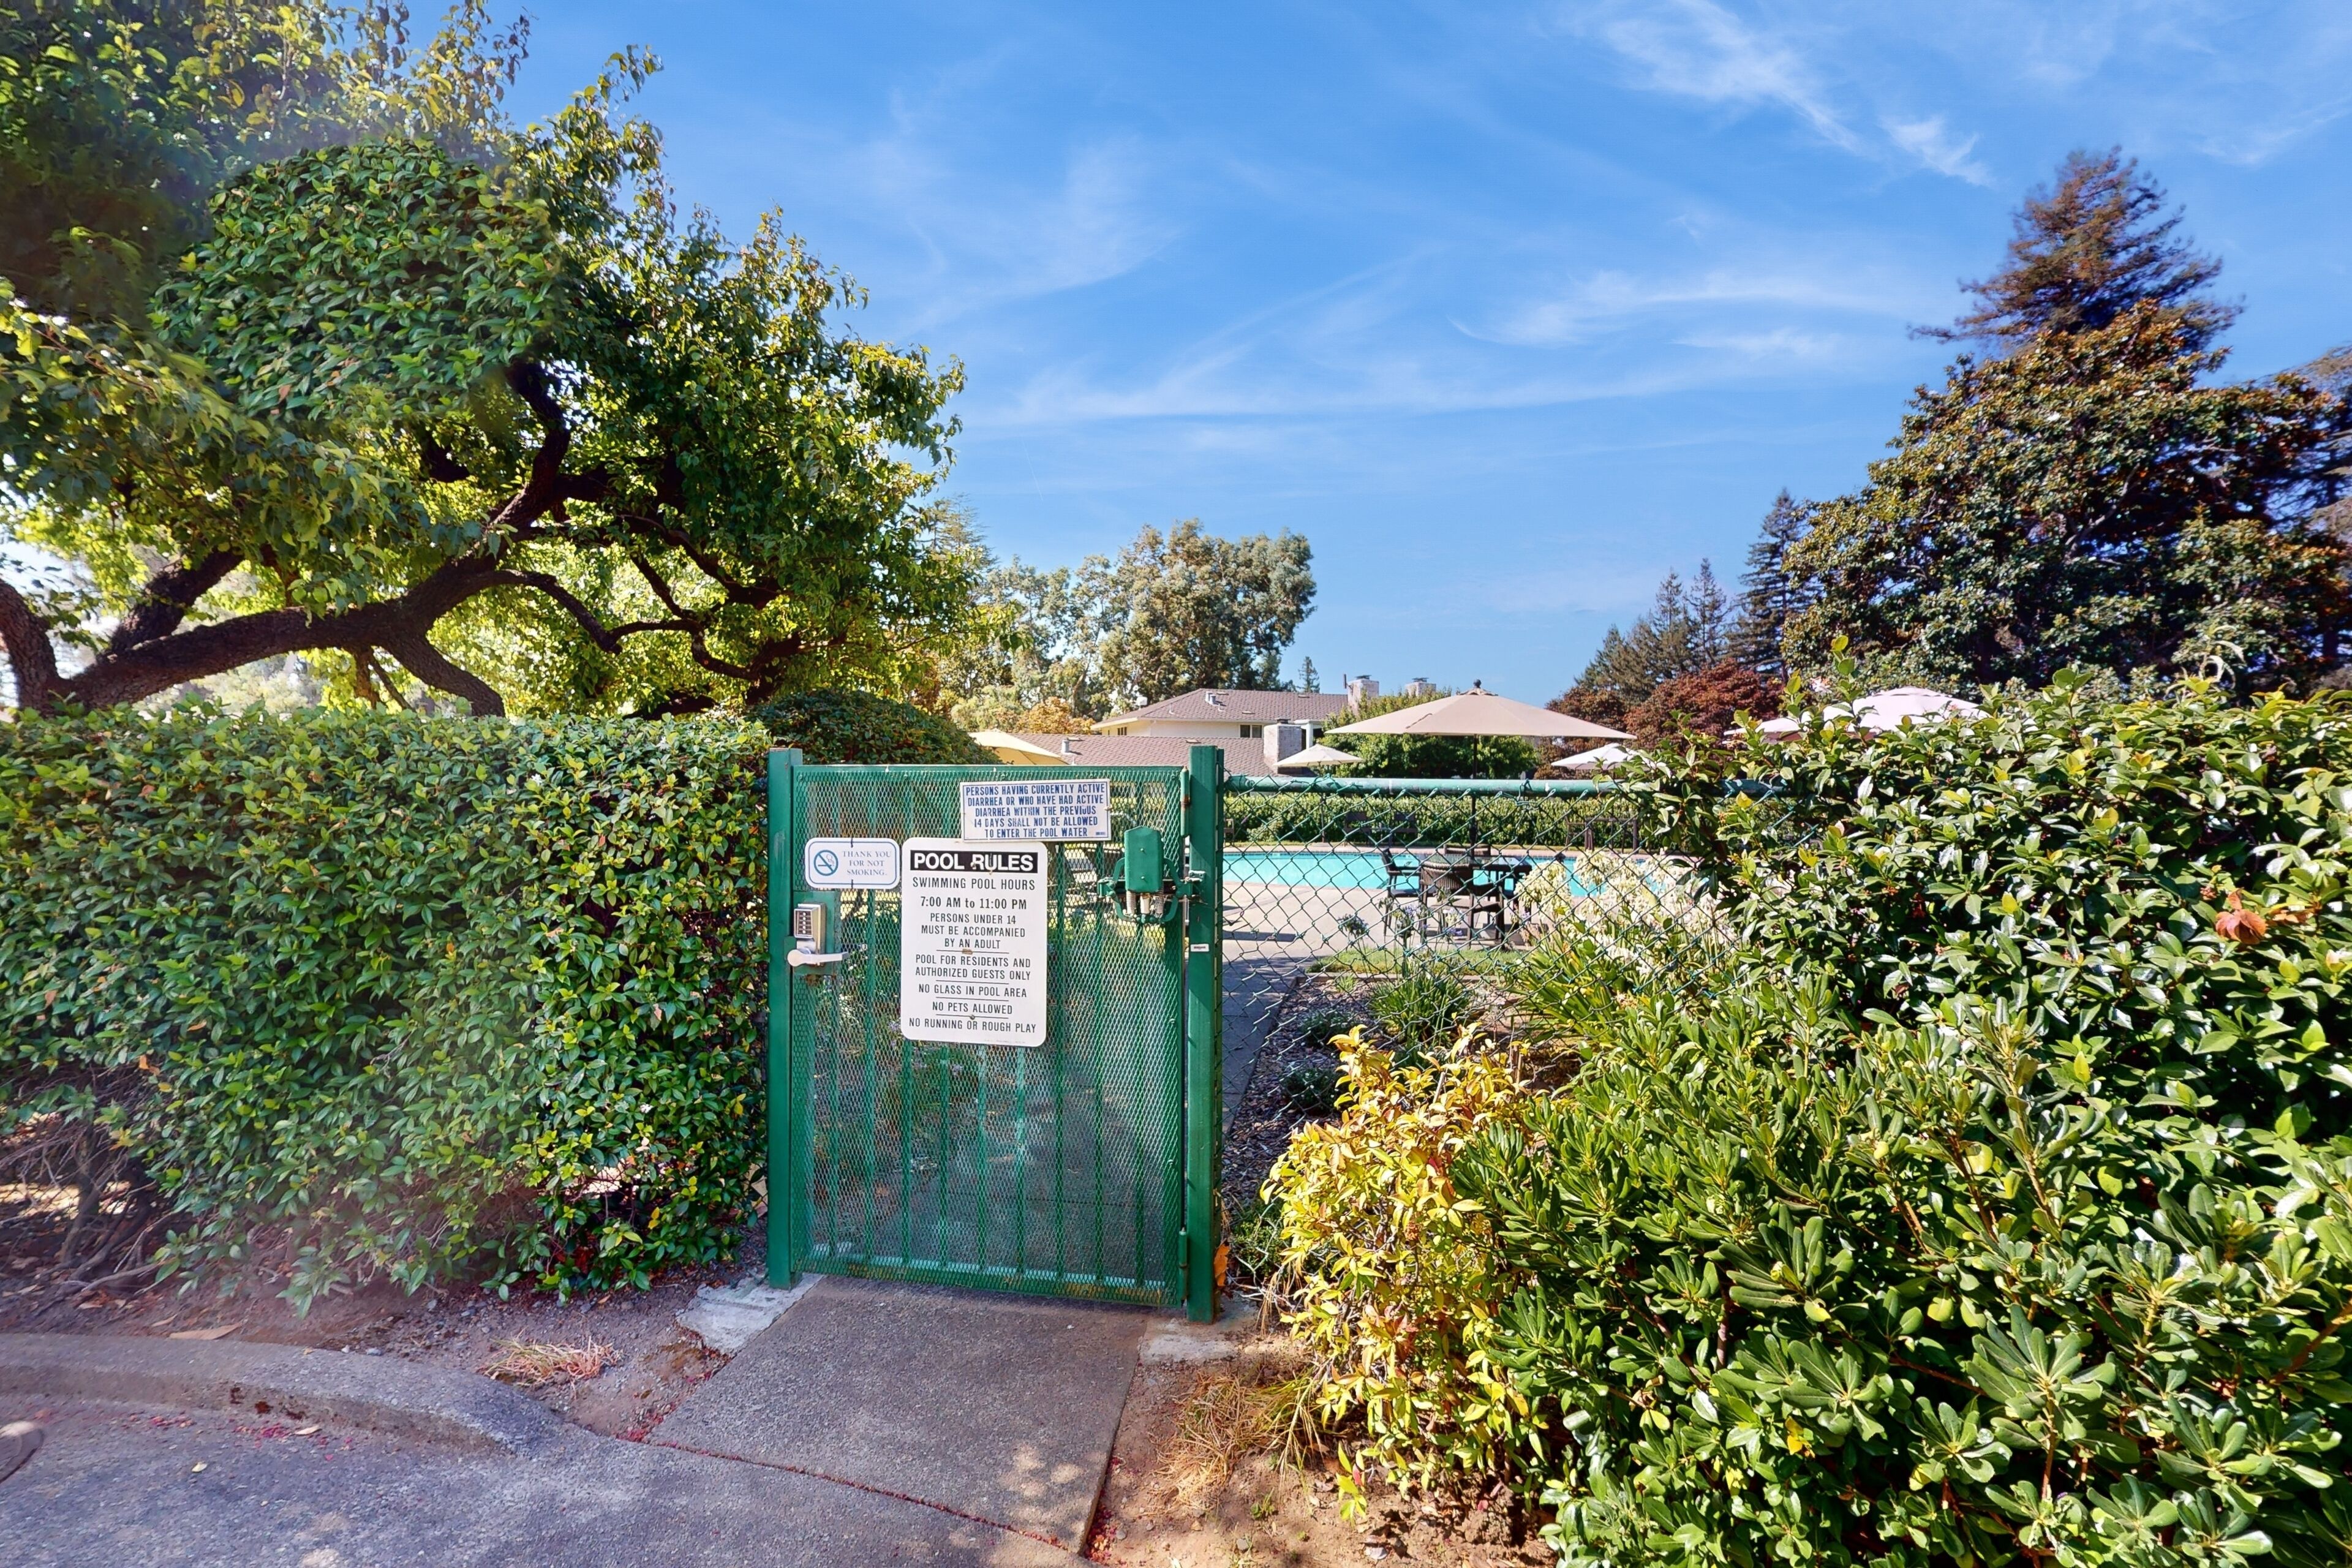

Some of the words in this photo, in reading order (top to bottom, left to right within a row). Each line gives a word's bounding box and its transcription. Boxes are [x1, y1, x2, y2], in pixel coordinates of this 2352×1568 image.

[966, 786, 998, 796] PERSONS
[1002, 785, 1028, 795] HAVING
[1031, 784, 1074, 794] CURRENTLY
[1078, 783, 1105, 793] ACTIVE
[968, 797, 1003, 806] DIARRHEA
[1006, 797, 1015, 805] OR
[1019, 796, 1033, 805] WHO
[1037, 796, 1055, 805] HAVE
[1059, 795, 1073, 804] HAD
[1077, 794, 1103, 804] ACTIVE
[975, 807, 1010, 817] DIARRHEA
[1014, 807, 1039, 816] WITHIN
[1043, 806, 1057, 815] THE
[1060, 805, 1096, 815] PREVIOUS
[974, 818, 981, 827] 14
[985, 818, 1005, 827] DAYS
[1008, 818, 1030, 827] SHALL
[1034, 817, 1048, 826] NOT
[1052, 817, 1060, 826] BE
[1063, 816, 1098, 826] ALLOWED
[985, 829, 993, 838] TO
[997, 828, 1020, 838] ENTER
[1023, 828, 1037, 837] THE
[1040, 827, 1058, 837] POOL
[1061, 827, 1088, 836] WATER
[914, 853, 965, 870] POOL
[971, 854, 1033, 871] RULES
[913, 877, 966, 888] SWIMMING
[971, 878, 996, 889] POOL
[1001, 879, 1035, 890] HOURS
[921, 896, 941, 907] 7:00
[946, 897, 960, 908] AM
[965, 898, 975, 908] to
[979, 898, 1007, 908] 11:00
[1012, 899, 1027, 910] PM
[930, 913, 970, 922] PERSONS
[974, 914, 1003, 924] UNDER
[1007, 915, 1016, 924] 14
[921, 925, 944, 935] MUST
[949, 925, 959, 935] BE
[963, 926, 1025, 937] ACCOMPANIED
[944, 938, 955, 947] BY
[959, 938, 970, 948] AN
[974, 939, 1001, 949] ADULT
[916, 954, 937, 964] POOL
[940, 956, 956, 965] FOR
[960, 956, 1009, 967] RESIDENTS
[1013, 958, 1030, 968] AND
[915, 967, 968, 978] AUTHORIZED
[972, 969, 1005, 979] GUESTS
[1009, 970, 1031, 980] ONLY
[919, 984, 930, 993] NO
[934, 984, 962, 995] GLASS
[966, 986, 974, 995] IN
[979, 986, 1000, 997] POOL
[1004, 987, 1027, 997] AREA
[932, 1002, 943, 1011] NO
[948, 1003, 968, 1012] PETS
[973, 1003, 1012, 1014] ALLOWED
[909, 1017, 920, 1027] NO
[924, 1018, 962, 1029] RUNNING
[967, 1020, 978, 1030] OR
[982, 1021, 1011, 1031] ROUGH
[1016, 1022, 1036, 1033] PLAY
